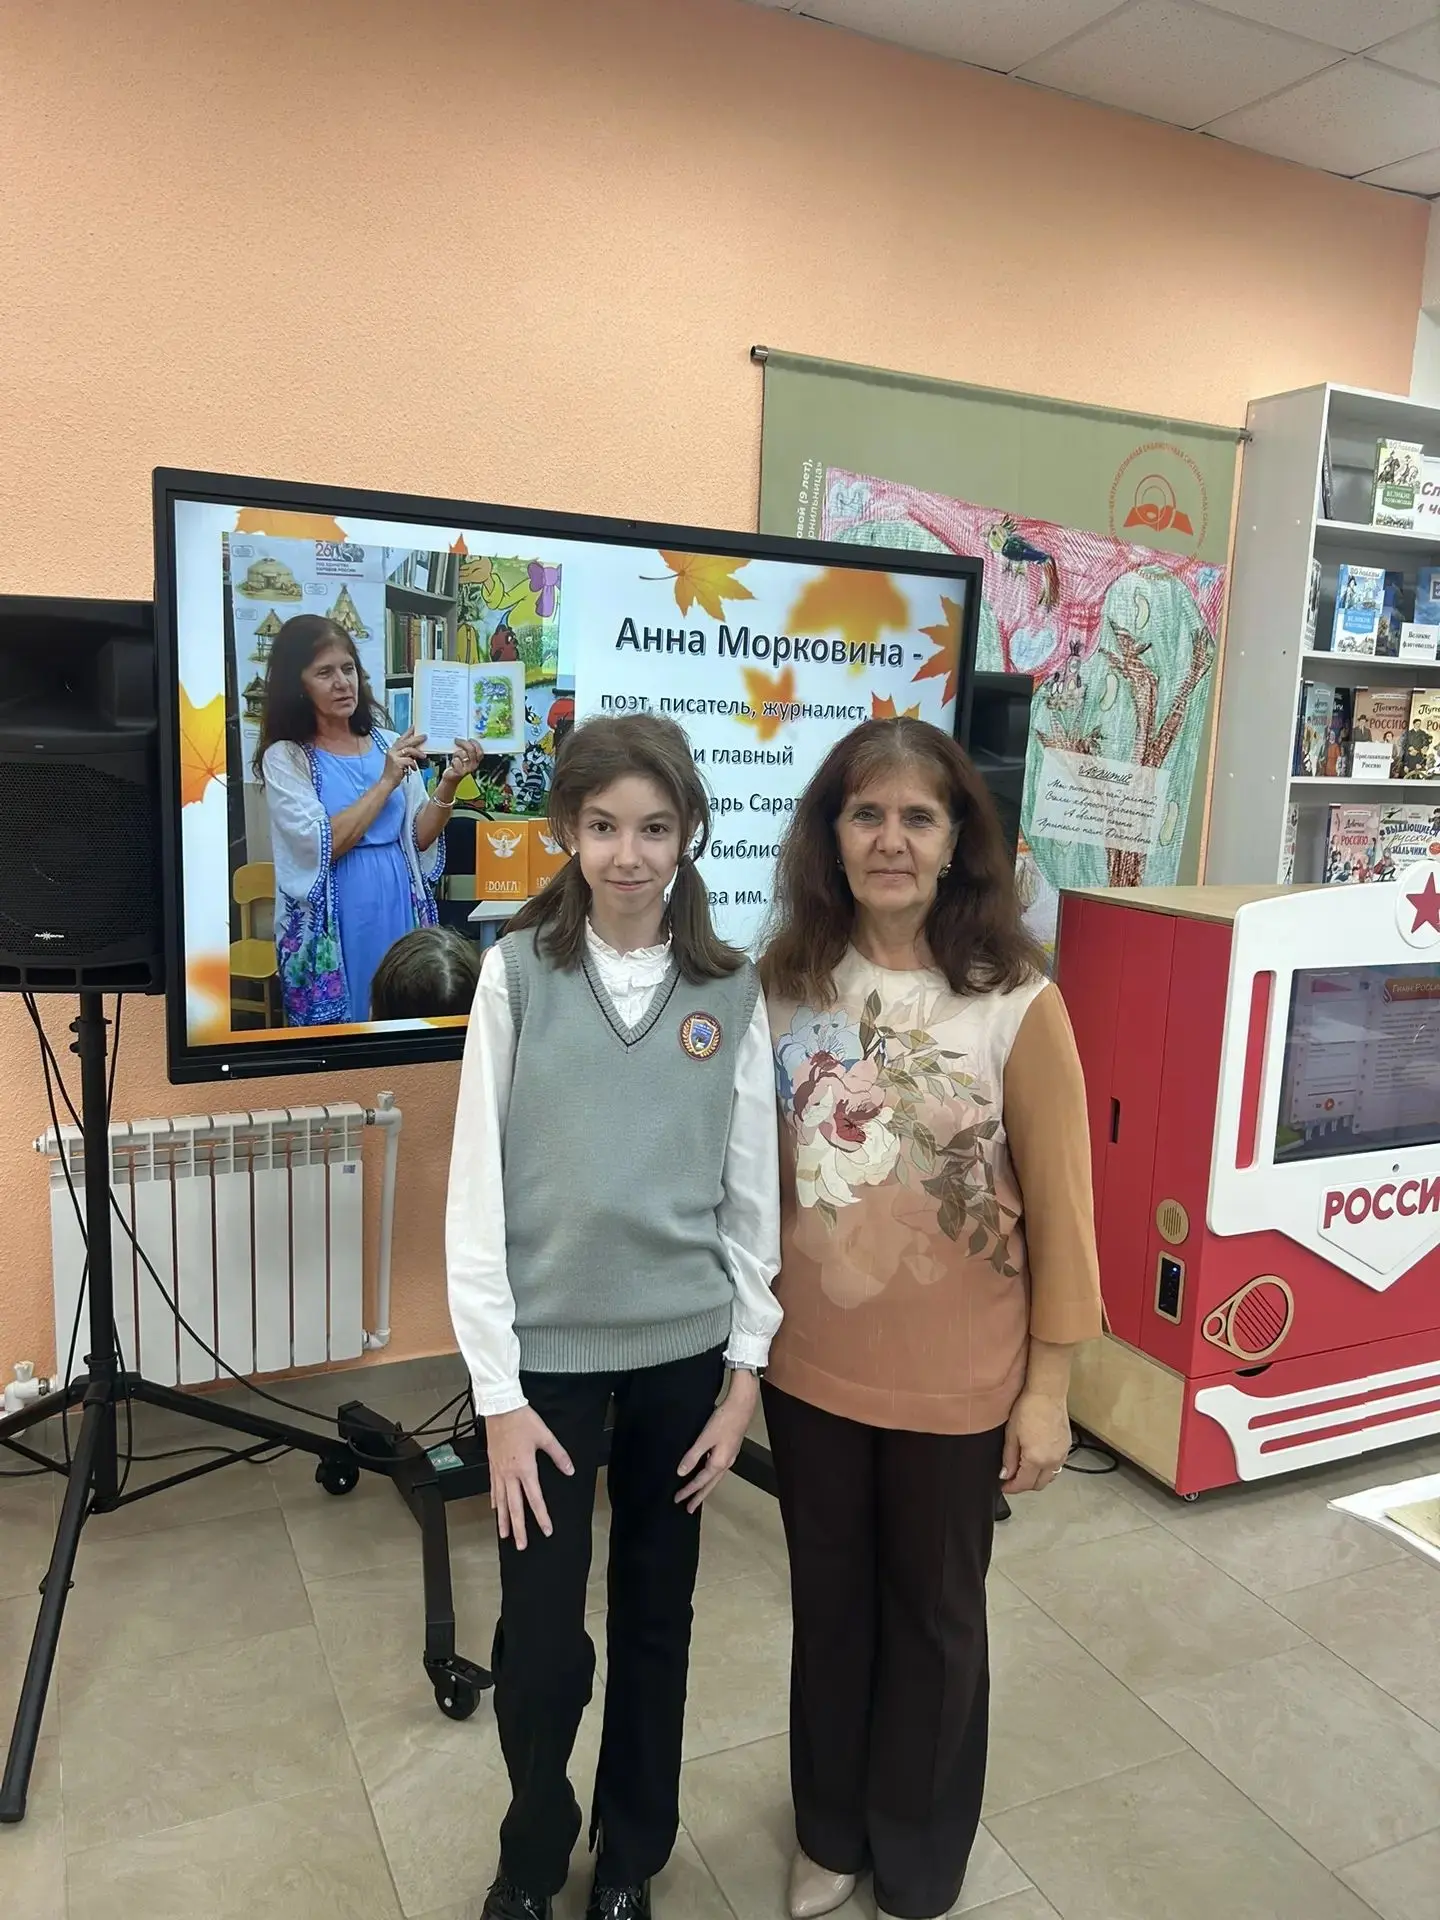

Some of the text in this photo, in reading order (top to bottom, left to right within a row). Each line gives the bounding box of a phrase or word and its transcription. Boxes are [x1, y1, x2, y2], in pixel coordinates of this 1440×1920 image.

[615, 617, 706, 656] Анна
[718, 624, 904, 668] Морковина
[601, 695, 868, 723] поэт, писатель, журналист,
[693, 745, 793, 765] и главный
[709, 796, 744, 816] арь
[735, 890, 768, 906] им.
